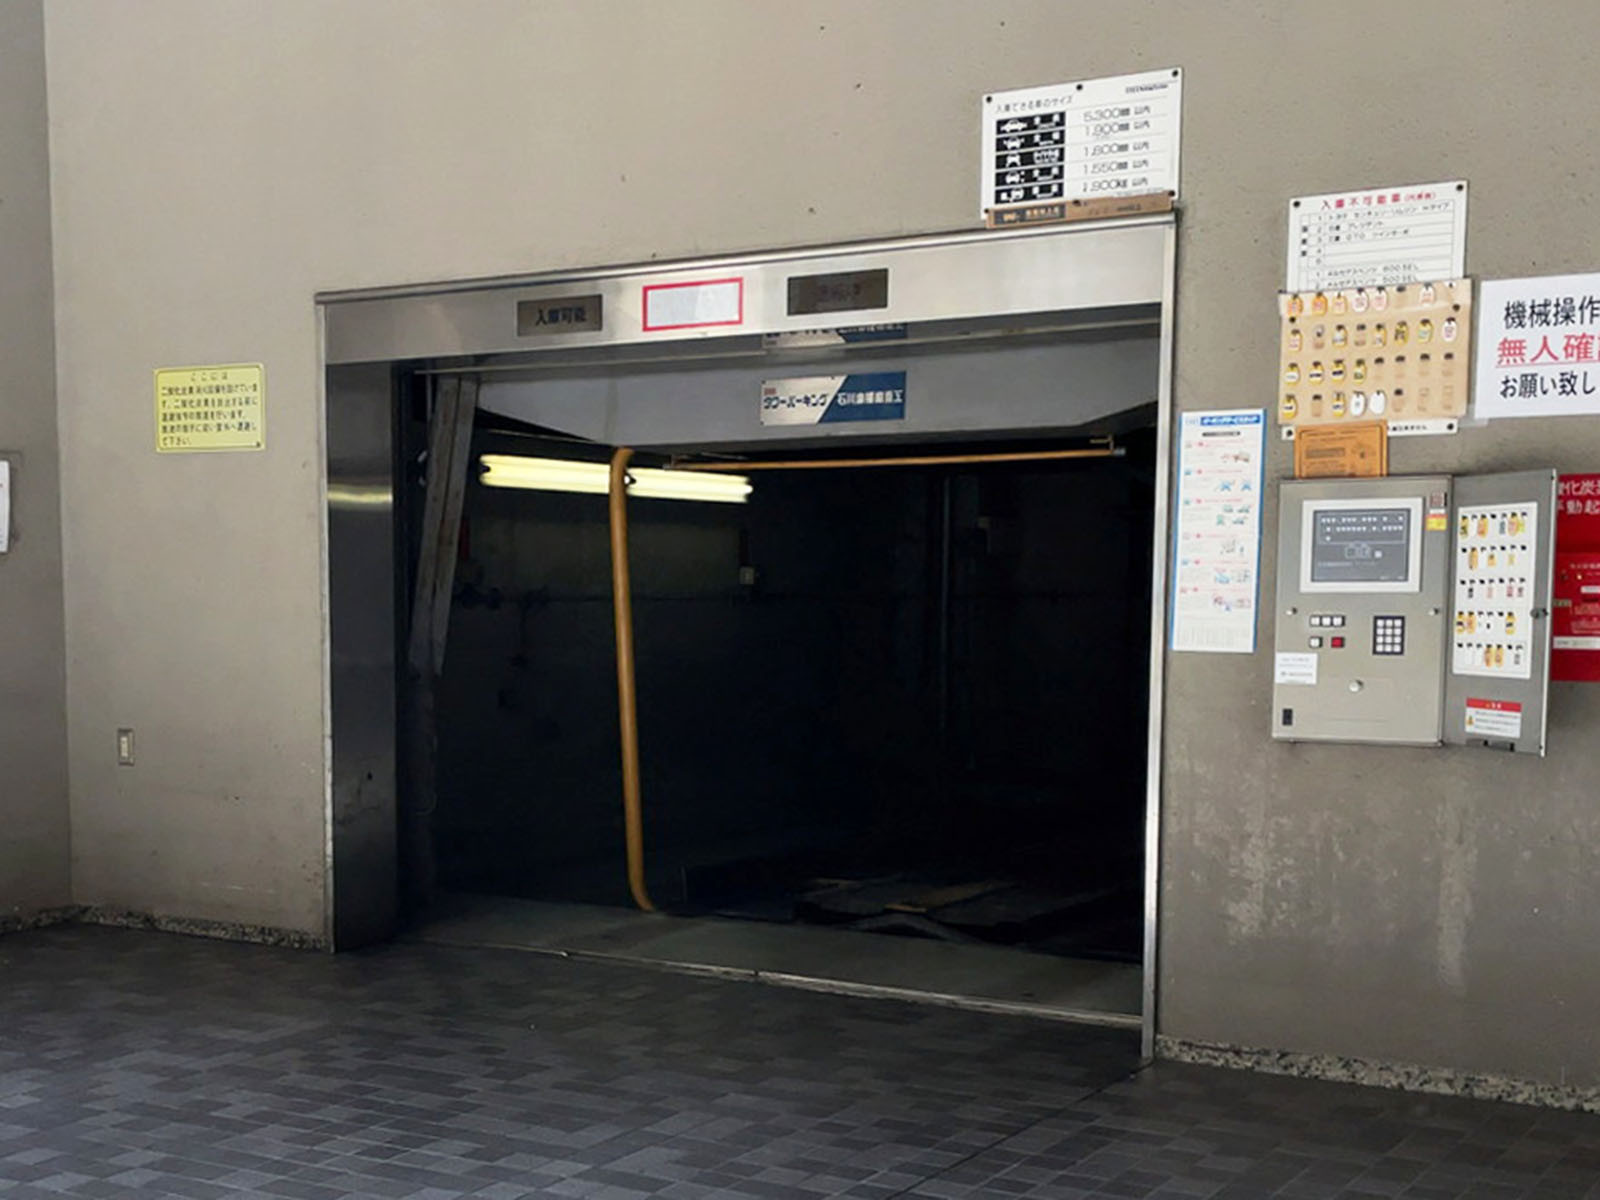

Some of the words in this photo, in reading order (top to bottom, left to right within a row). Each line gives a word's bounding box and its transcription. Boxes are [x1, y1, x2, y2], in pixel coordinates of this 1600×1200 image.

[1504, 295, 1600, 329] 機械操作
[1497, 332, 1600, 364] 無人確
[1500, 370, 1596, 398] お願い致し
